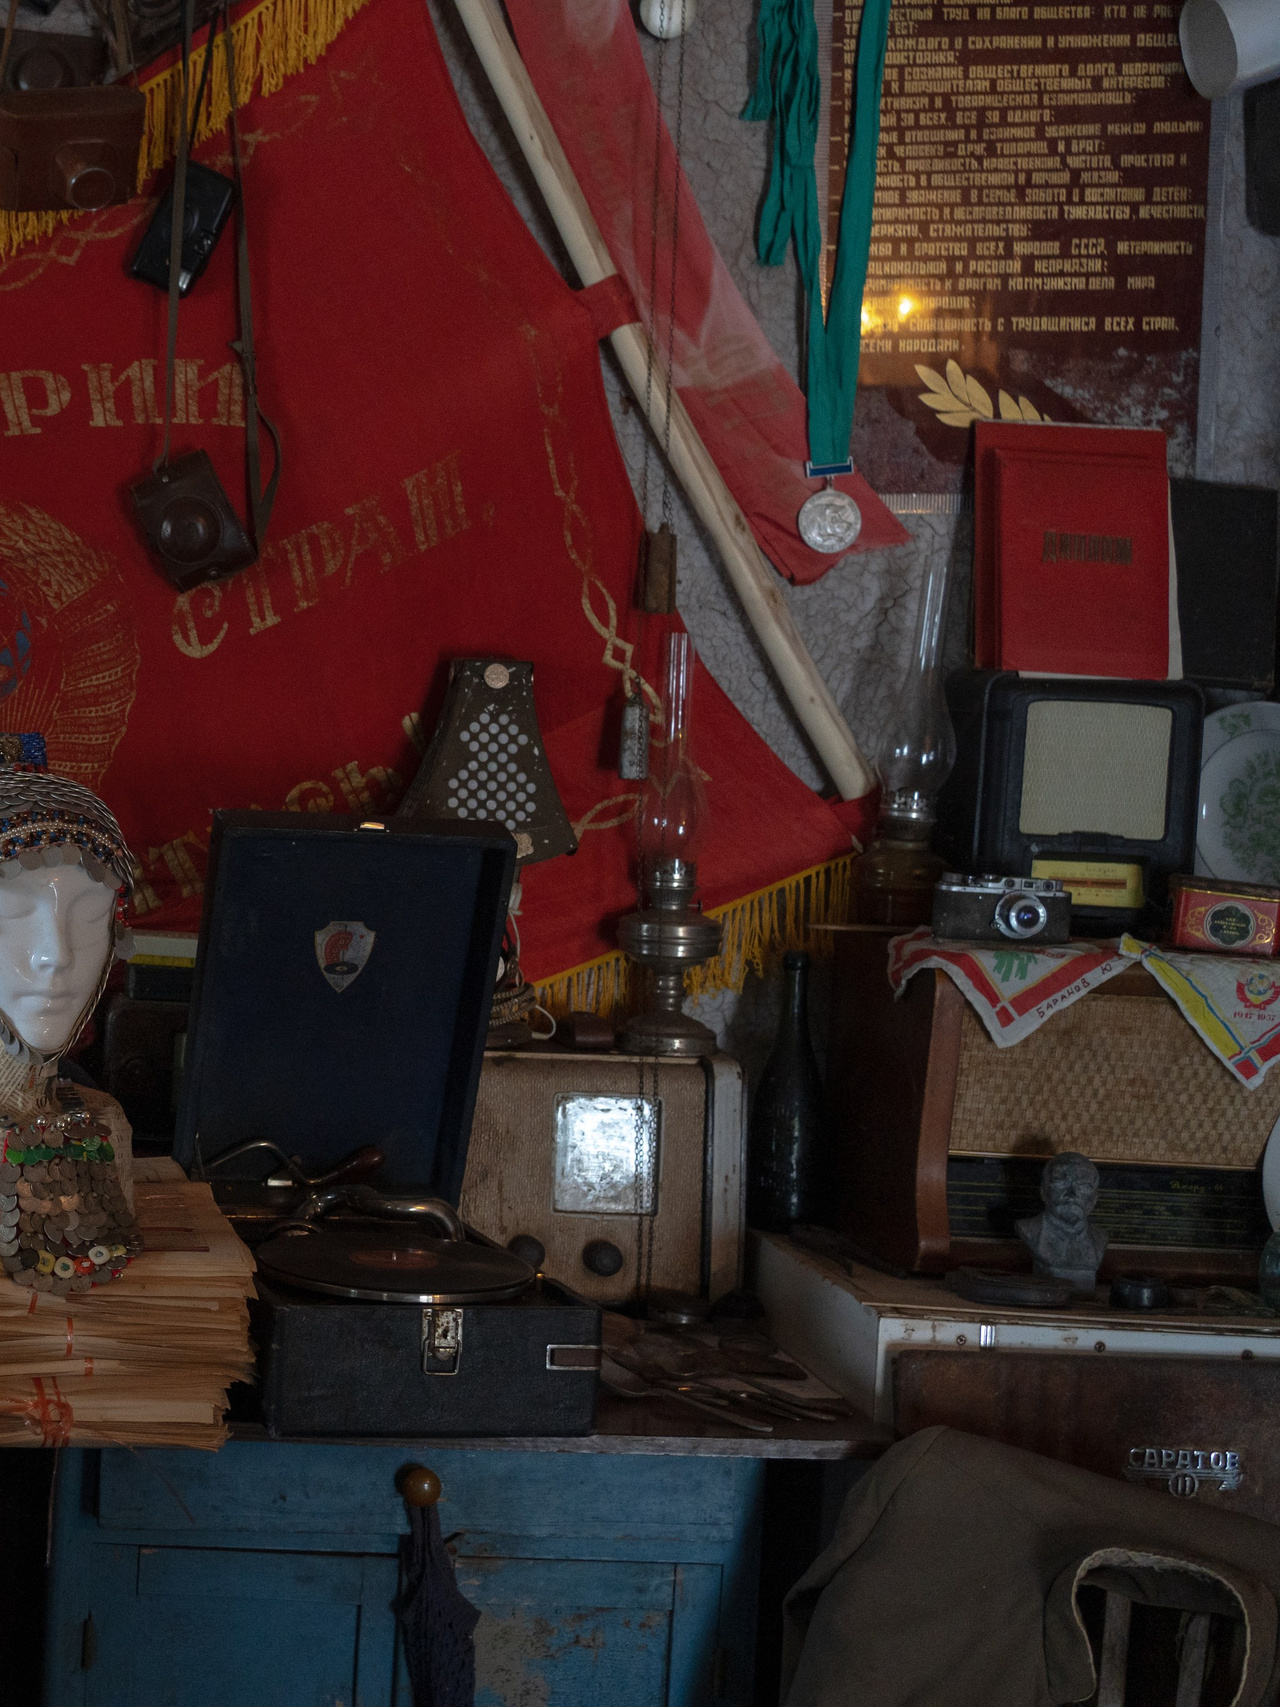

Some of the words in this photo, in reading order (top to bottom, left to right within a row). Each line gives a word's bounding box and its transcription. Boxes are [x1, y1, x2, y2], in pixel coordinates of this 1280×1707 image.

[942, 6, 970, 20] ТРУД
[977, 6, 991, 20] НА
[996, 6, 1029, 20] БЛАГО
[1104, 5, 1127, 19] КТО
[1133, 5, 1148, 19] НЕ
[887, 37, 949, 51] КАЖДОГО
[968, 35, 1042, 49] СОХРАНЕНИИ
[1047, 35, 1055, 48] И
[1058, 34, 1131, 48] УМНОЖЕНИИ
[904, 66, 964, 80] СОЗНАНИЕ
[969, 64, 1070, 79] ОБЩЕСТВЕННОГО
[904, 79, 990, 94] НАРУШИТЕЛЯМ
[996, 77, 1093, 92] ОБЩЕСТВЕННЫХ
[956, 111, 978, 125] ВСЕ
[985, 110, 1000, 124] ЗА
[1107, 122, 1147, 136] МЕЖДУ
[976, 241, 1005, 256] ВСЕХ
[1127, 275, 1156, 290] МИРА
[1105, 316, 1135, 332] ВСЕХ
[1036, 978, 1090, 1018] БАРАНОВ
[1129, 1448, 1240, 1470] САРАТОВ
